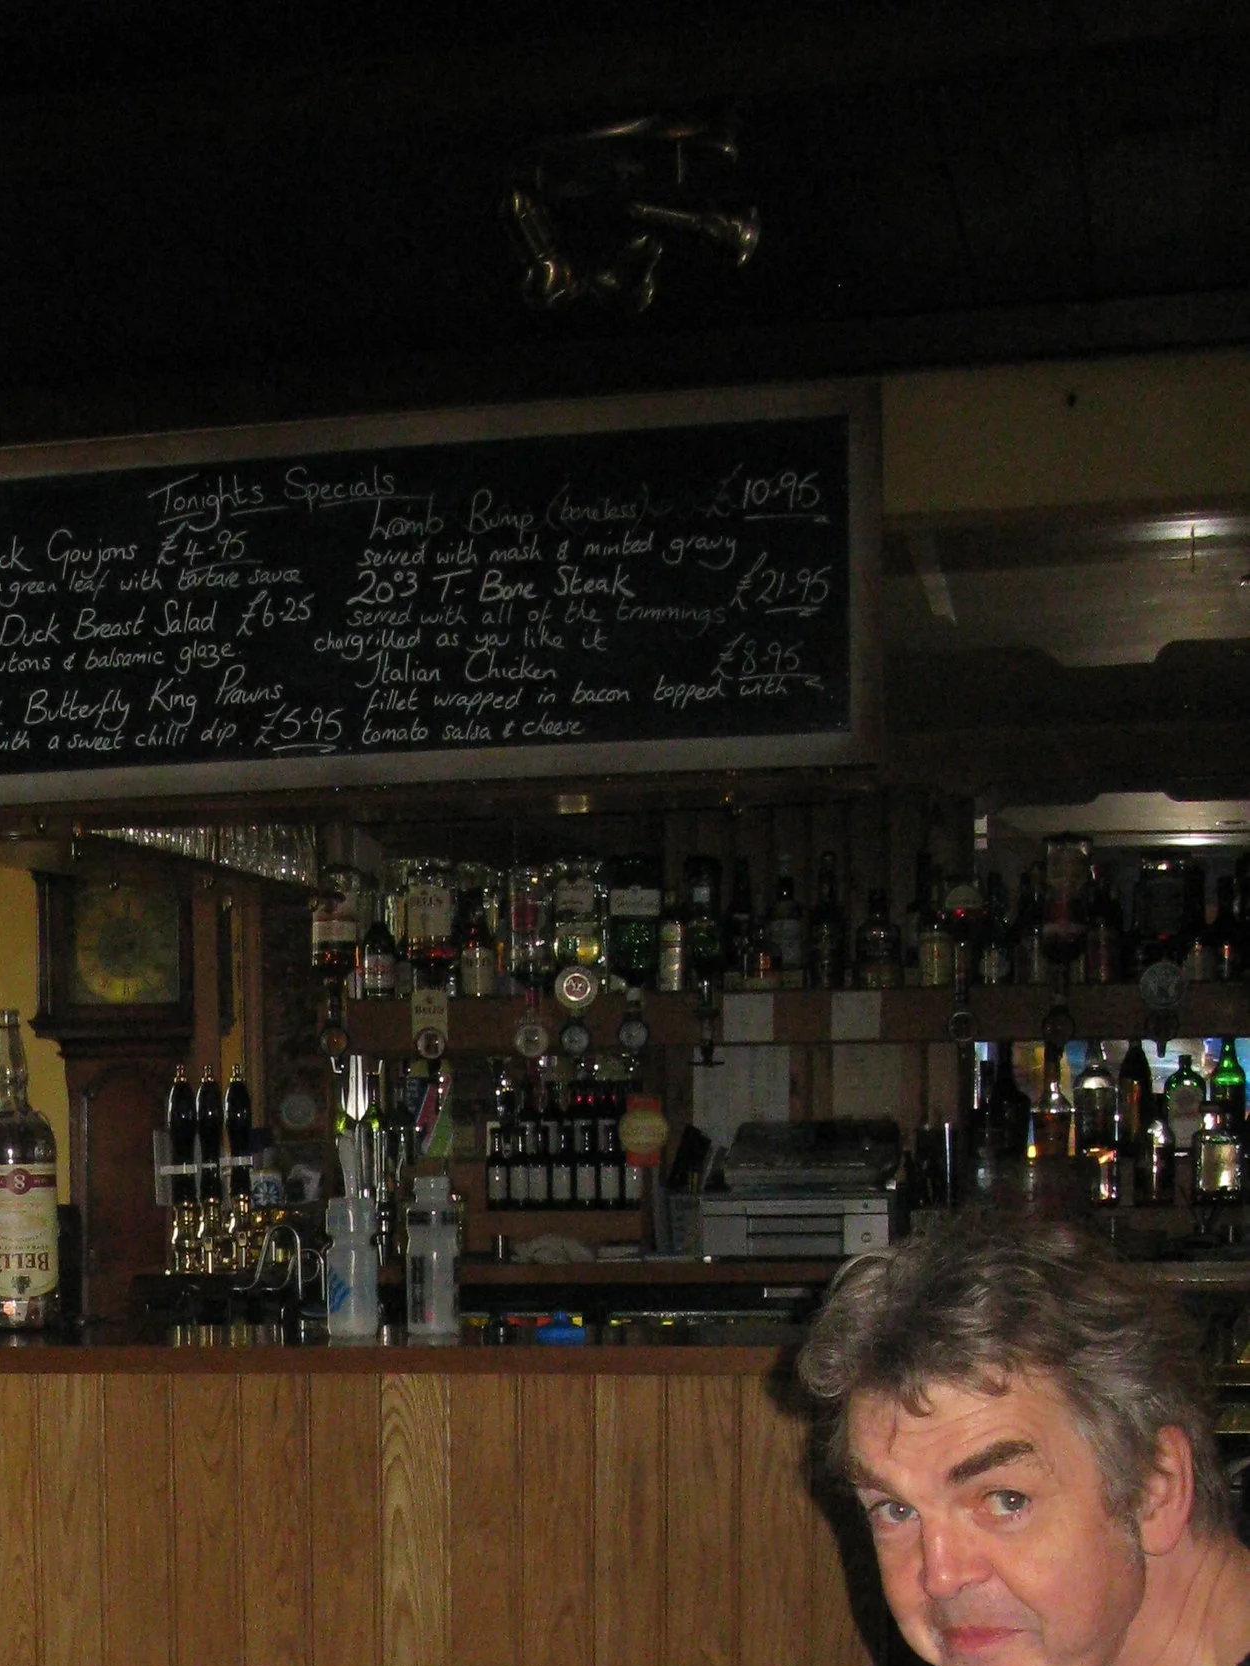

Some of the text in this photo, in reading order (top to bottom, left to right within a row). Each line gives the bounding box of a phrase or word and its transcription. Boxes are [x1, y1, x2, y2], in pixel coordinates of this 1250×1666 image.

[148, 465, 395, 532] Tonights Specials
[369, 494, 444, 540] Lamb
[466, 489, 534, 544] Rump
[47, 529, 138, 580] Goujons
[355, 527, 737, 570] served with mash & minted gravy
[69, 570, 110, 601] leaf
[120, 568, 162, 591] with
[178, 566, 240, 591] tartare
[248, 568, 303, 585] sauce
[553, 563, 636, 598] Steak
[0, 612, 61, 647] Duck
[72, 606, 145, 640] Breast
[154, 600, 217, 636] Salad
[346, 598, 726, 640] served with all of the trimmings
[63, 652, 76, 671] &
[84, 642, 166, 671] balsamic
[313, 627, 421, 661] chargrilled
[436, 632, 459, 647] as
[524, 625, 565, 649] like
[582, 628, 608, 651] it
[354, 650, 442, 688] Italian
[465, 648, 558, 682] Chicken
[23, 688, 130, 731] Butterfly
[148, 677, 198, 727] King
[215, 664, 283, 705] Prawns
[363, 674, 788, 720] fillet wrapped in bacon topped with
[48, 735, 59, 749] a
[67, 730, 125, 750] sweet
[135, 719, 188, 747] chilli
[361, 717, 429, 744] tomato
[441, 719, 492, 740] salsa
[521, 712, 585, 736] cheese
[13, 1174, 26, 1189] 8
